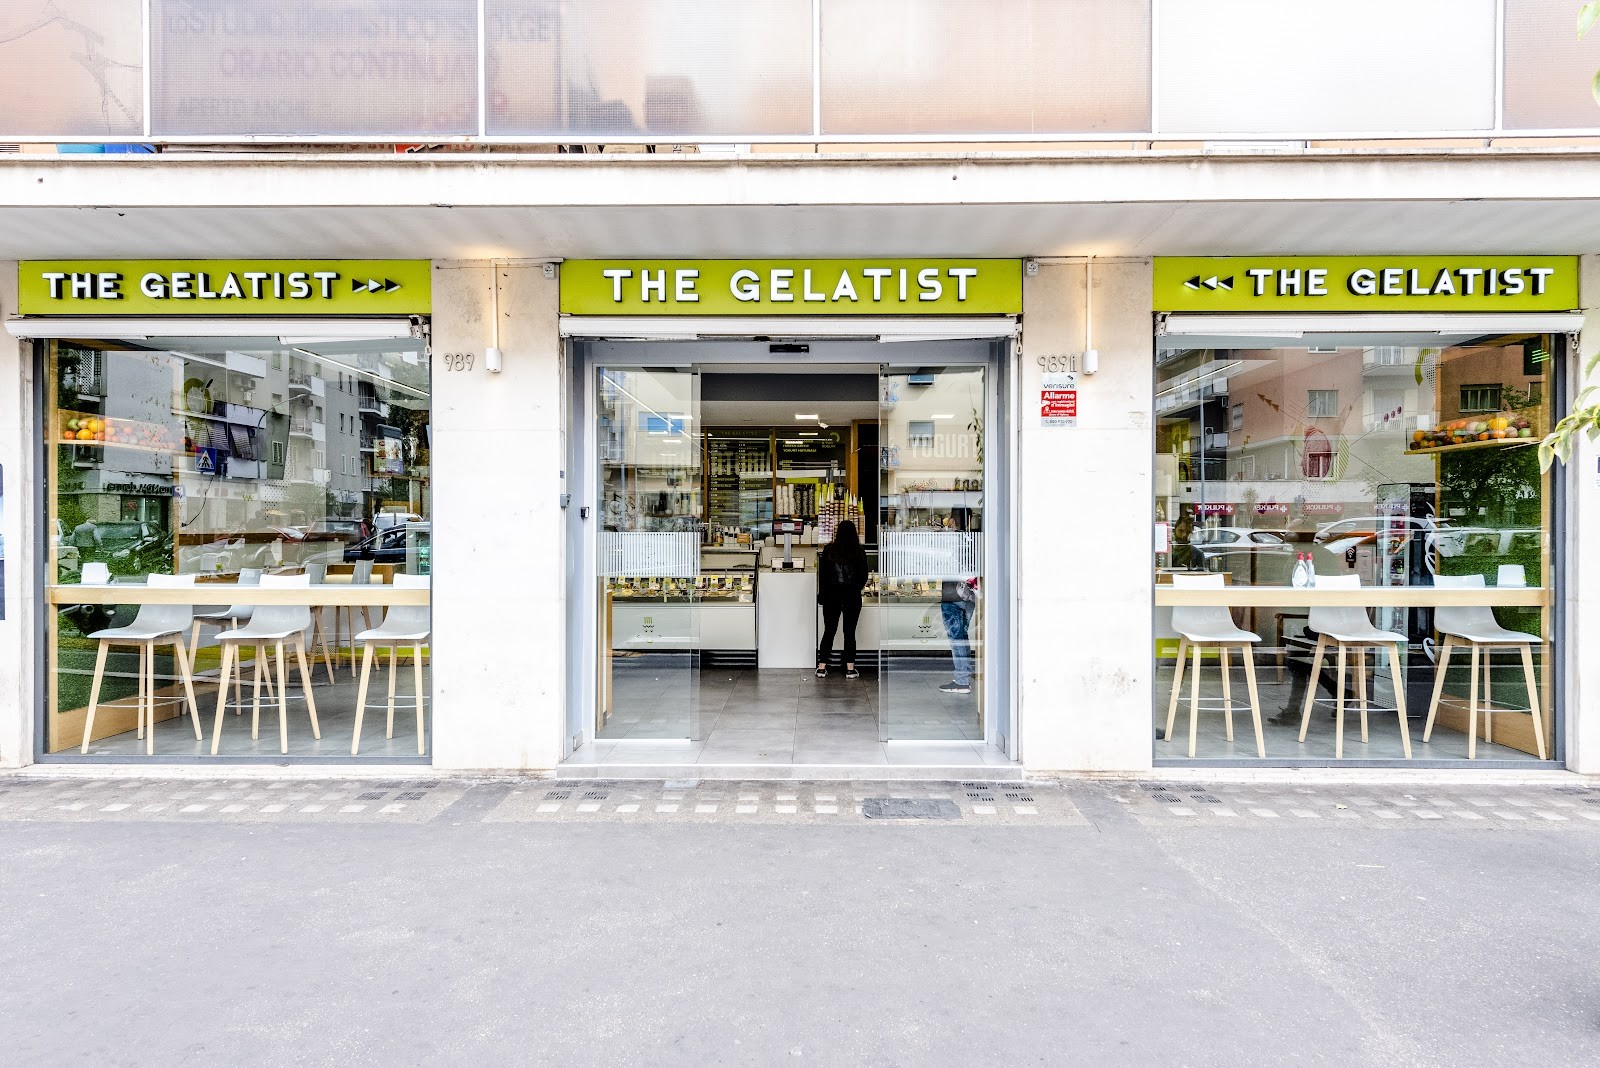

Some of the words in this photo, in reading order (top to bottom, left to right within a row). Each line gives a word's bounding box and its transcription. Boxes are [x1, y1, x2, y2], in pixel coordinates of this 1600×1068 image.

[218, 48, 320, 79] ORARIO
[41, 272, 123, 299] THE
[140, 272, 340, 299] GELATIST
[603, 268, 700, 303] THE
[729, 268, 979, 302] GELATIST
[1246, 268, 1328, 296] THE
[1347, 268, 1555, 296] GELATIST
[443, 352, 475, 372] 989
[1043, 392, 1075, 400] Allarme
[909, 433, 979, 458] YOGURT
